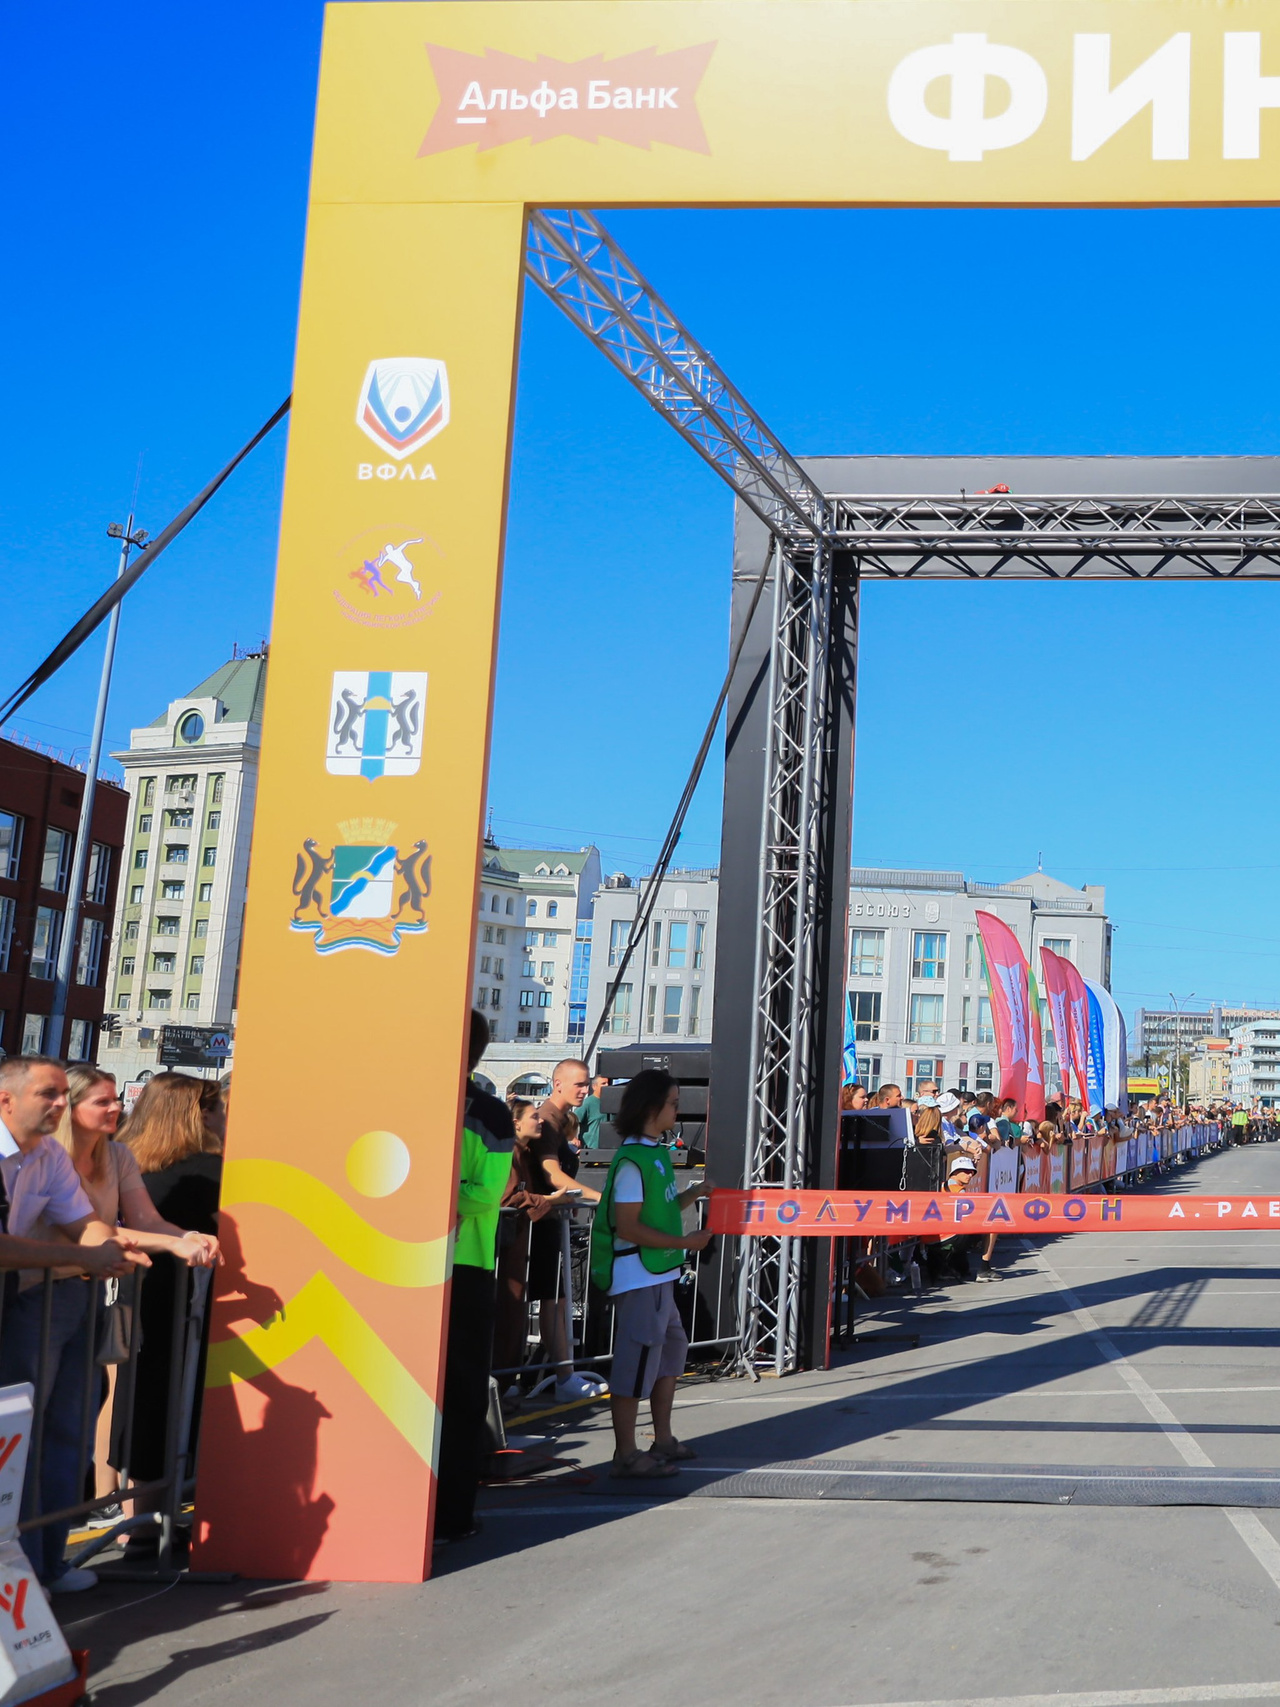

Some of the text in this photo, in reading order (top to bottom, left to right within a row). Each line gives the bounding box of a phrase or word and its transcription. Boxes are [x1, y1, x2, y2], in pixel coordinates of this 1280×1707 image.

[457, 78, 680, 119] Альфа Банк
[358, 462, 438, 481] ВФЛА
[744, 1197, 1122, 1225] ПОЛУМАРАФОН
[1168, 1201, 1200, 1218] А.
